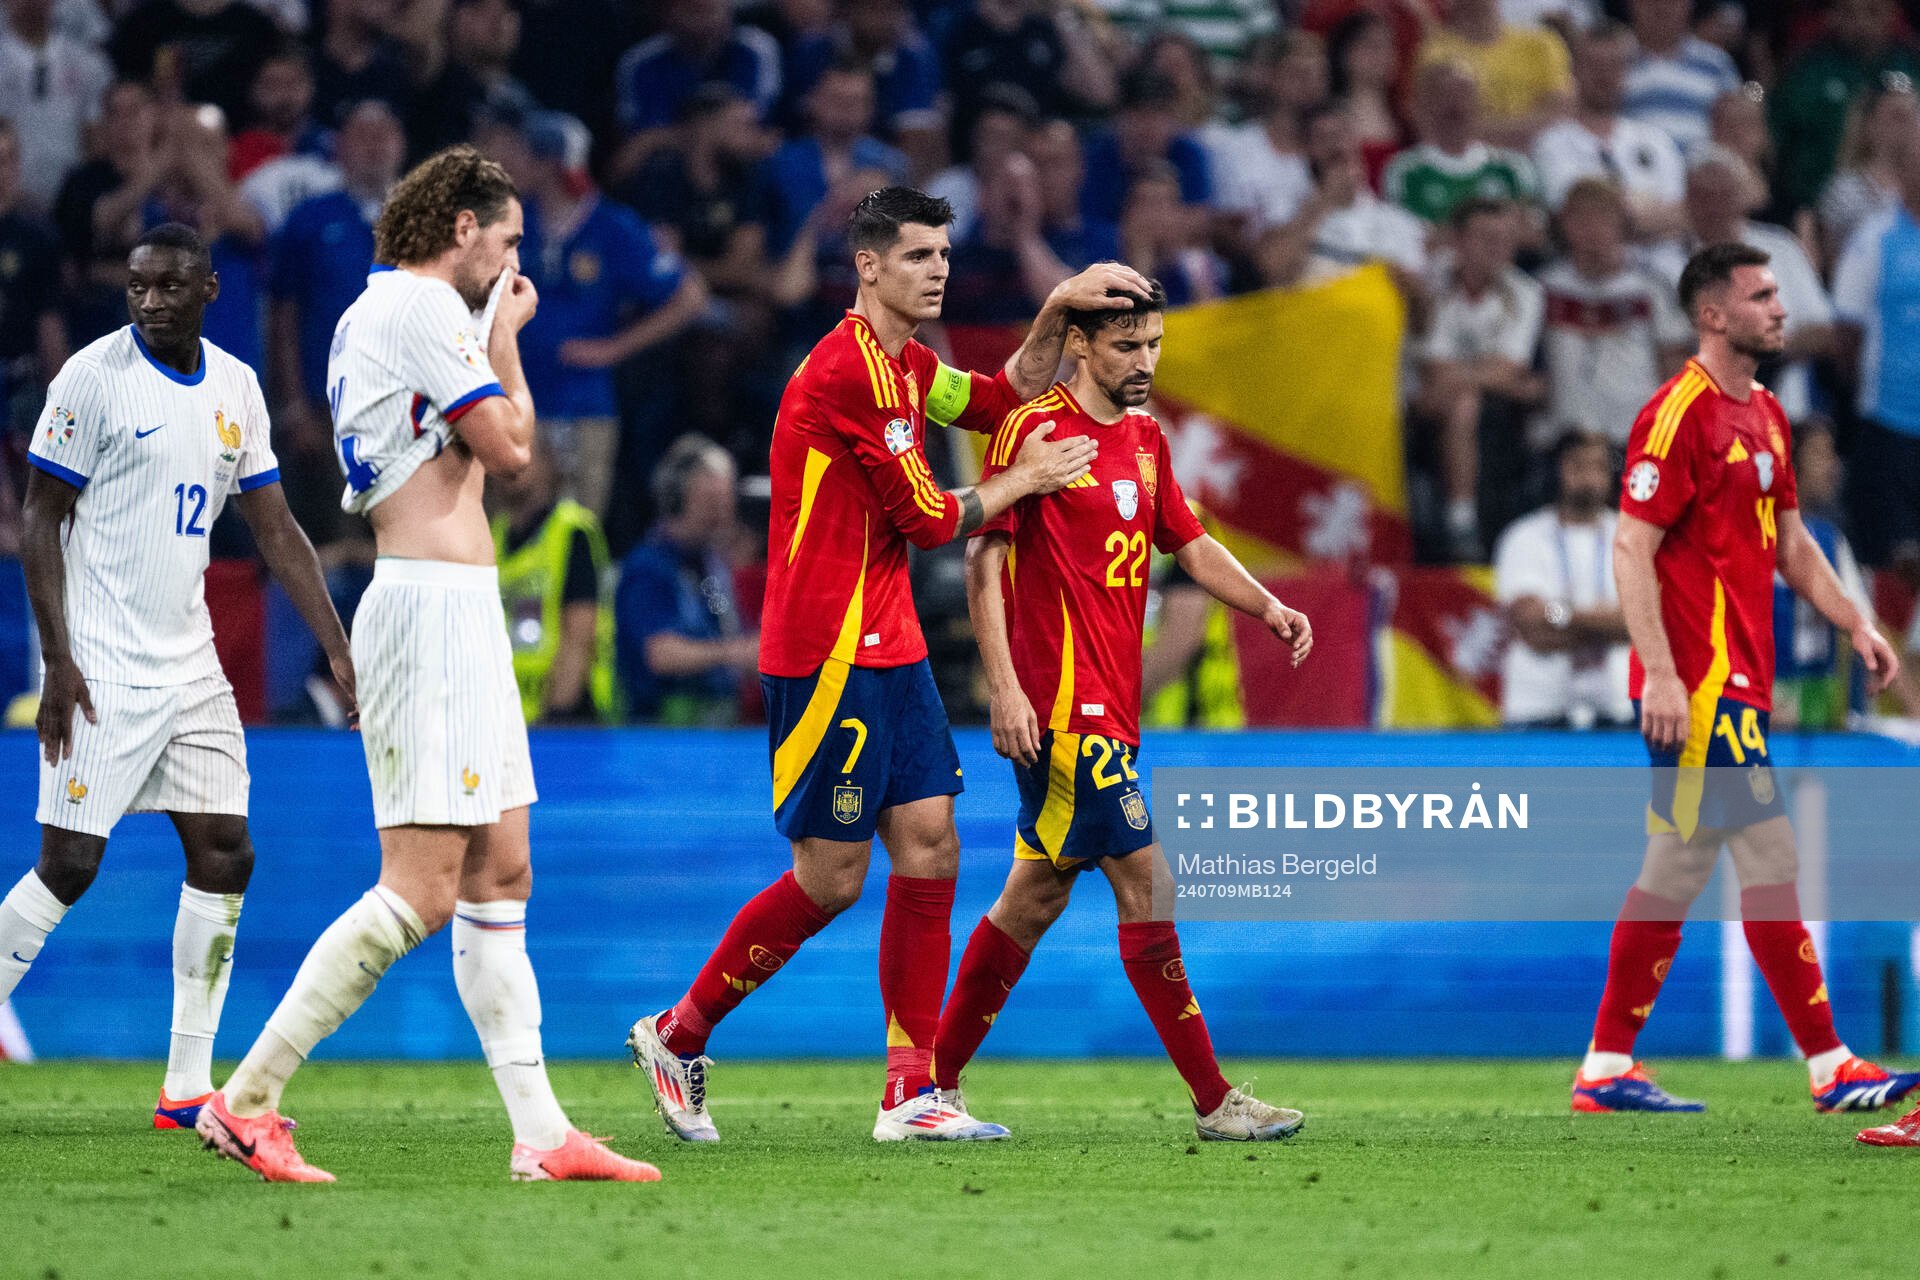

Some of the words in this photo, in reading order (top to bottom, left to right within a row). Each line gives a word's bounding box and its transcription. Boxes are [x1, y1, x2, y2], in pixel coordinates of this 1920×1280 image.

[174, 483, 206, 537] 12
[1755, 497, 1776, 550] 14
[1105, 530, 1147, 588] 22
[839, 717, 868, 774] 7
[1081, 733, 1139, 791] 22
[1716, 708, 1767, 764] 14
